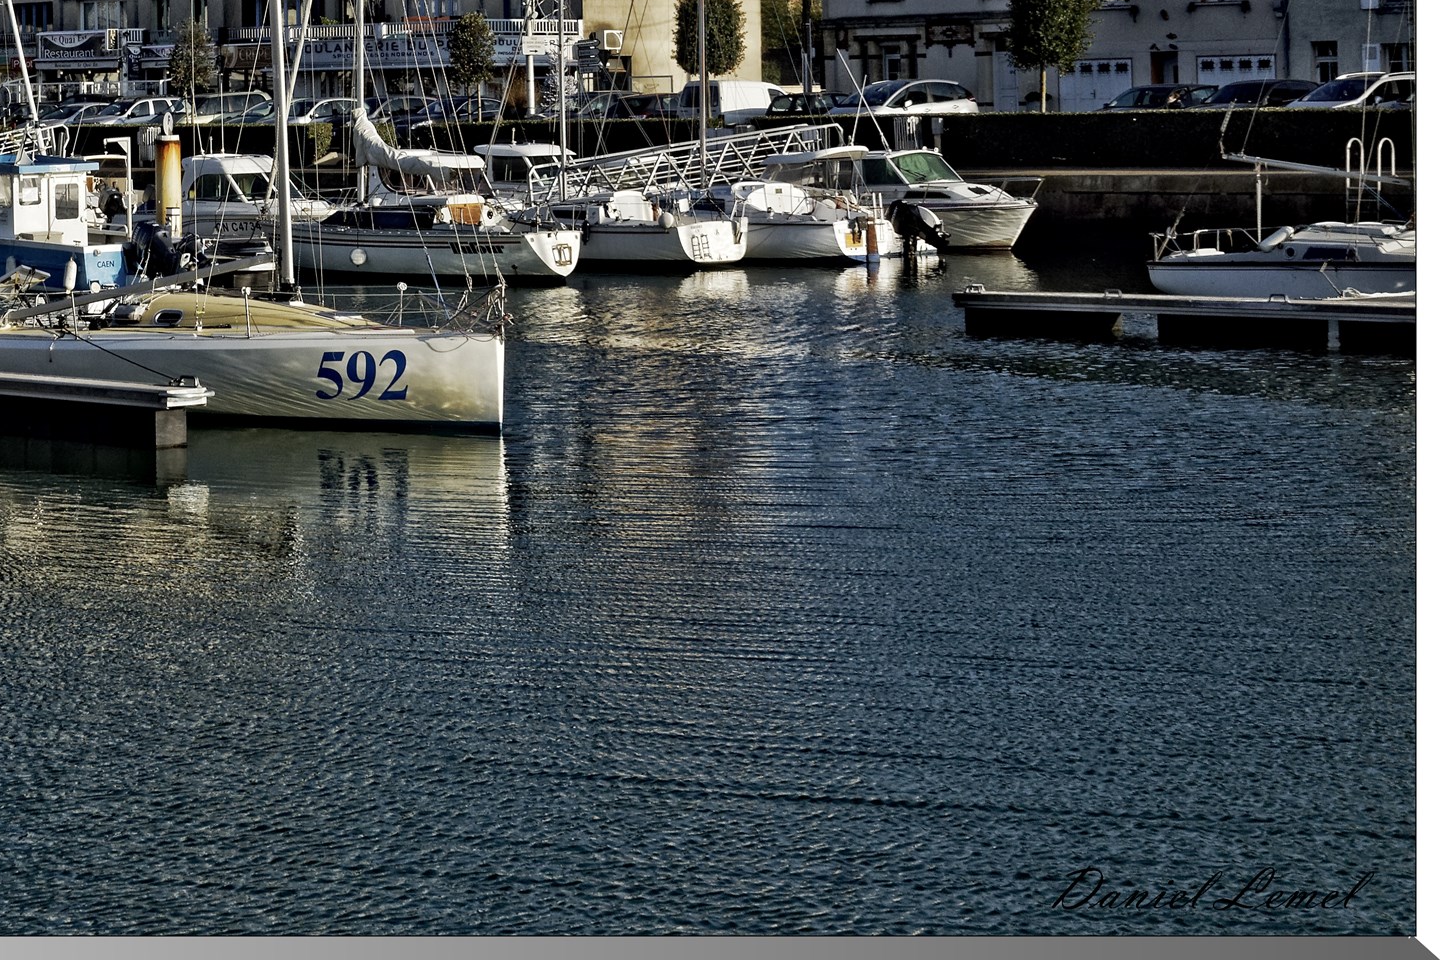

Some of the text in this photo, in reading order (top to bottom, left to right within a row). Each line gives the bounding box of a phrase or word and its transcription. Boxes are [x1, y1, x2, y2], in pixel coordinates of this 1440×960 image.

[292, 41, 399, 54] OULANERIE
[44, 49, 95, 58] Restaurant
[96, 260, 115, 269] CAEN
[315, 349, 409, 401] 592
